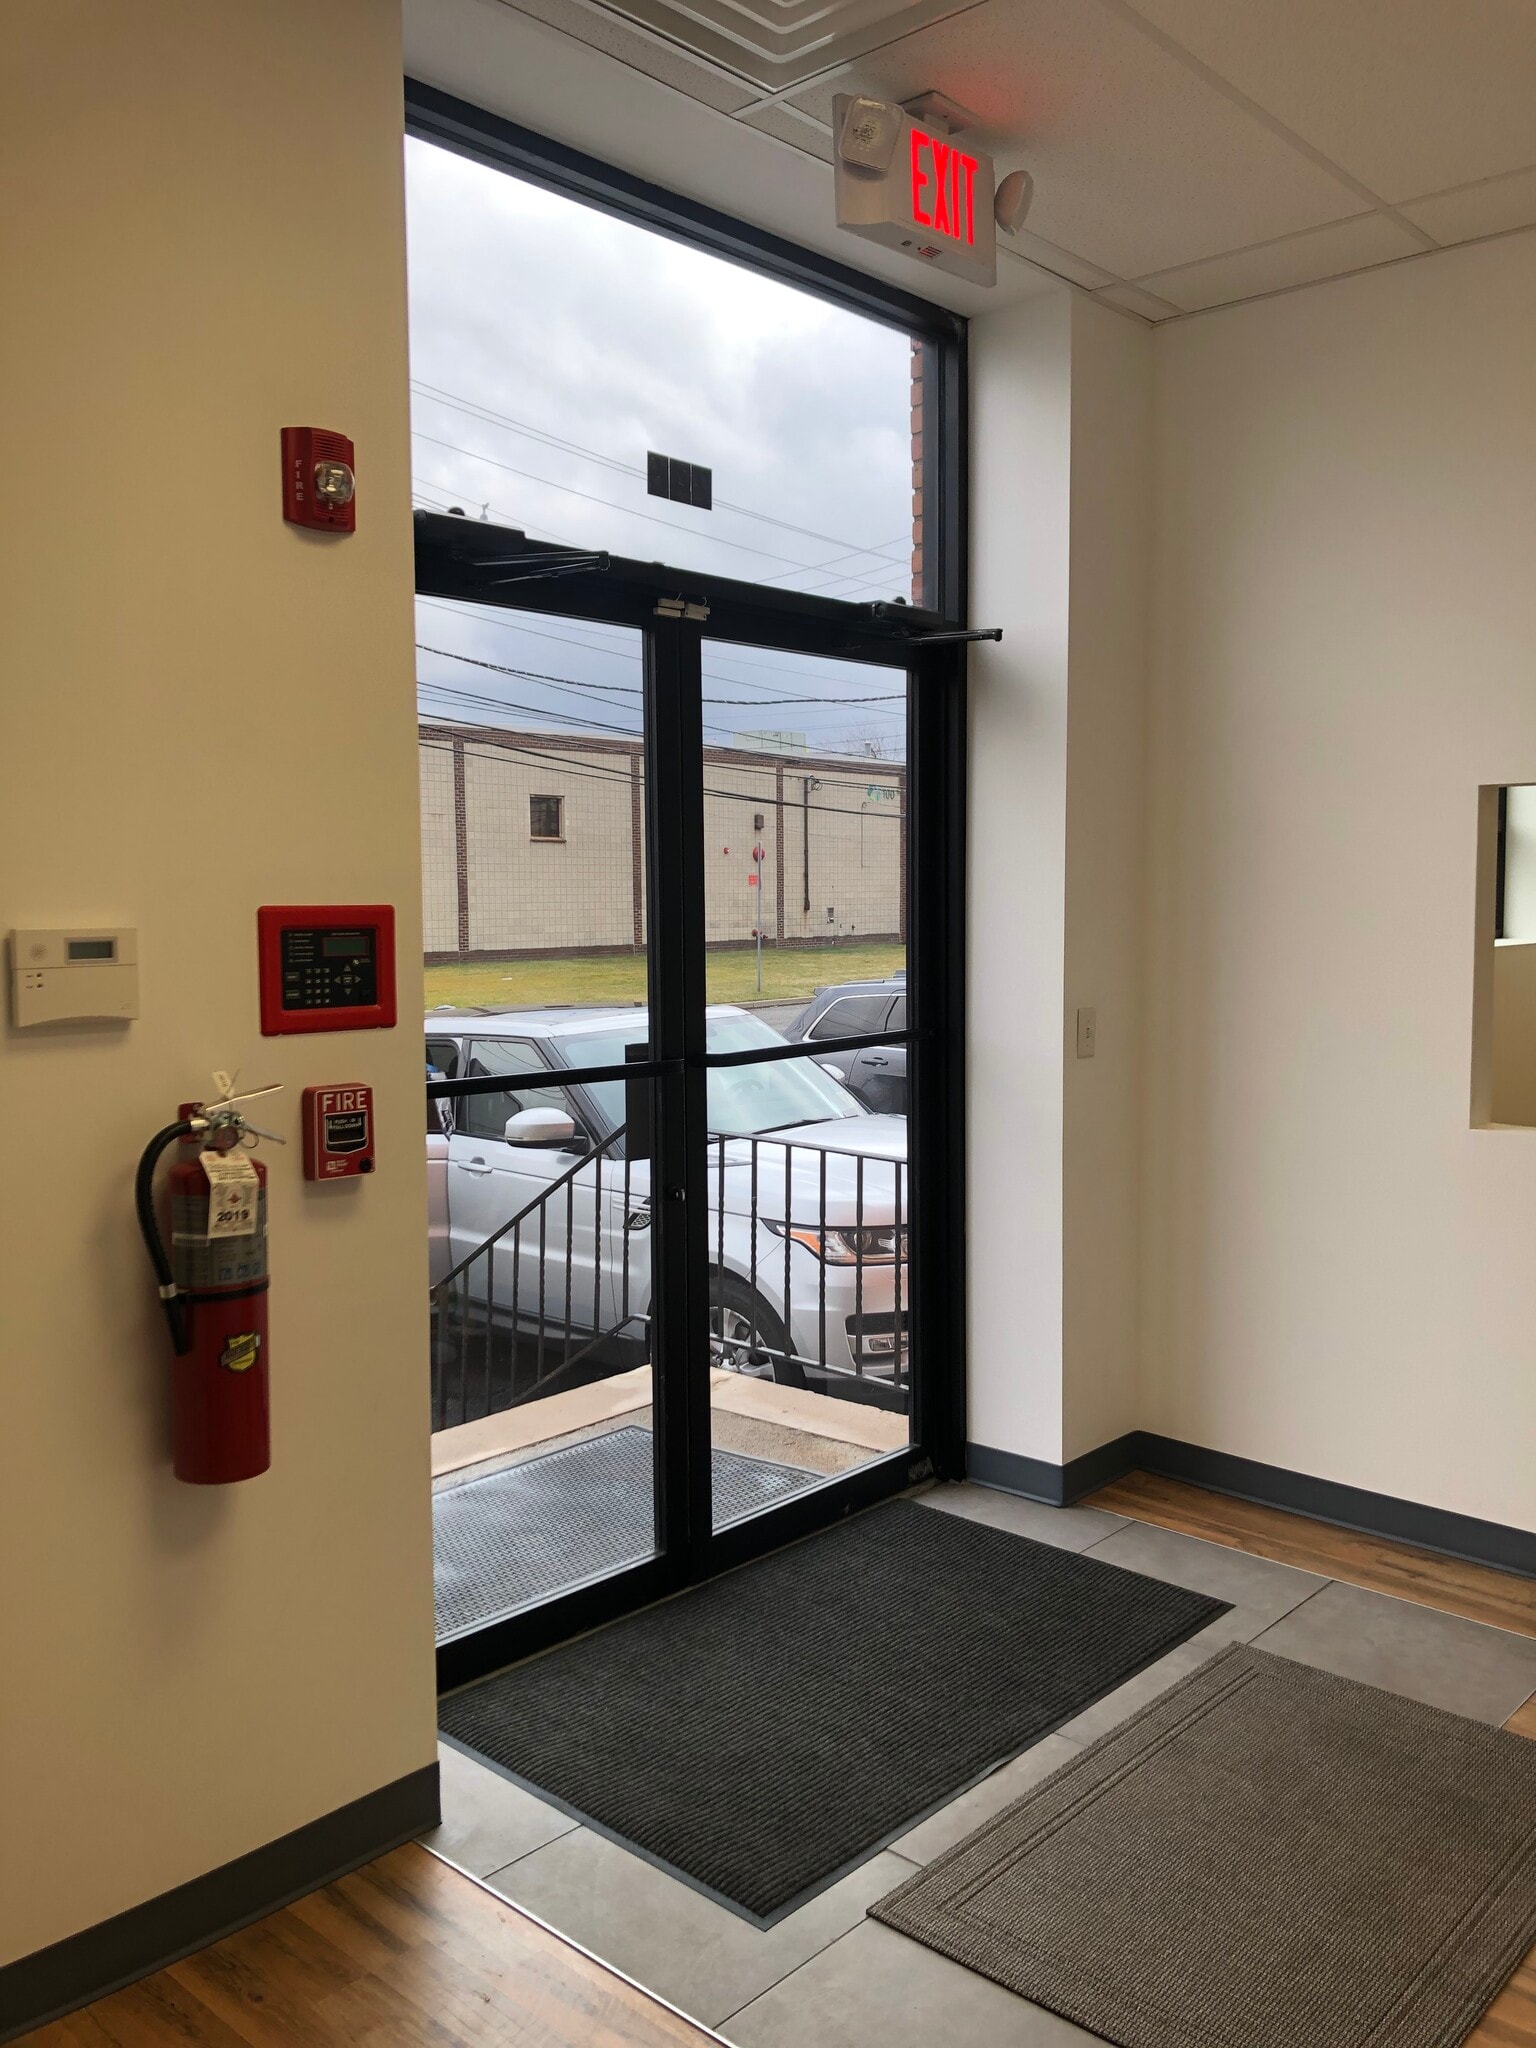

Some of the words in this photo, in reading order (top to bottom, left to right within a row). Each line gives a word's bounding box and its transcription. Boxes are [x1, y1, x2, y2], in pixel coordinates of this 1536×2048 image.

[911, 128, 978, 246] EXIT
[295, 460, 304, 501] FIRE
[322, 1090, 367, 1112] FIRE
[217, 1209, 249, 1222] 2019
